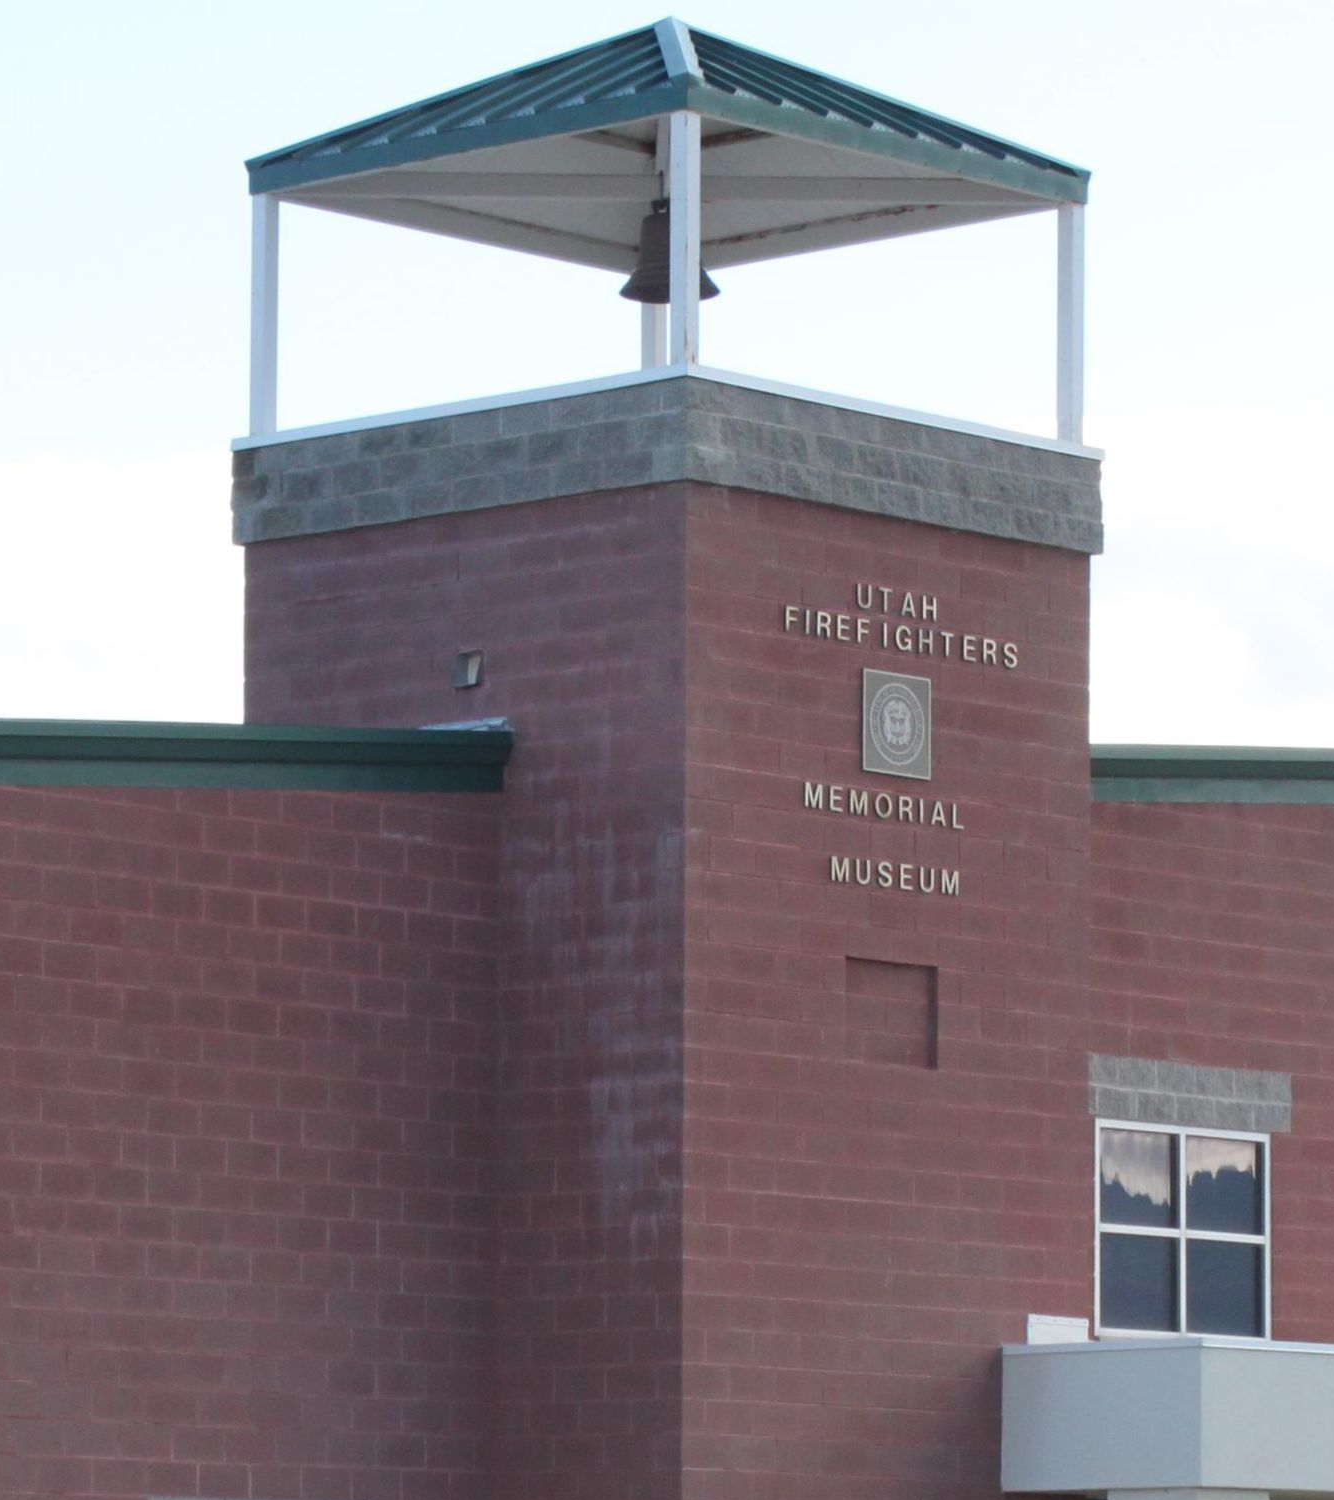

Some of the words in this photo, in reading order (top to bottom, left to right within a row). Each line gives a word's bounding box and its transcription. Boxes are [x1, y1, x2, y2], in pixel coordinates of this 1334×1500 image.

[856, 583, 938, 621] UTAH
[784, 605, 1019, 669] FIREFIGHTERS
[804, 782, 965, 830] MEMORIAL
[830, 856, 960, 896] MUSEUM
